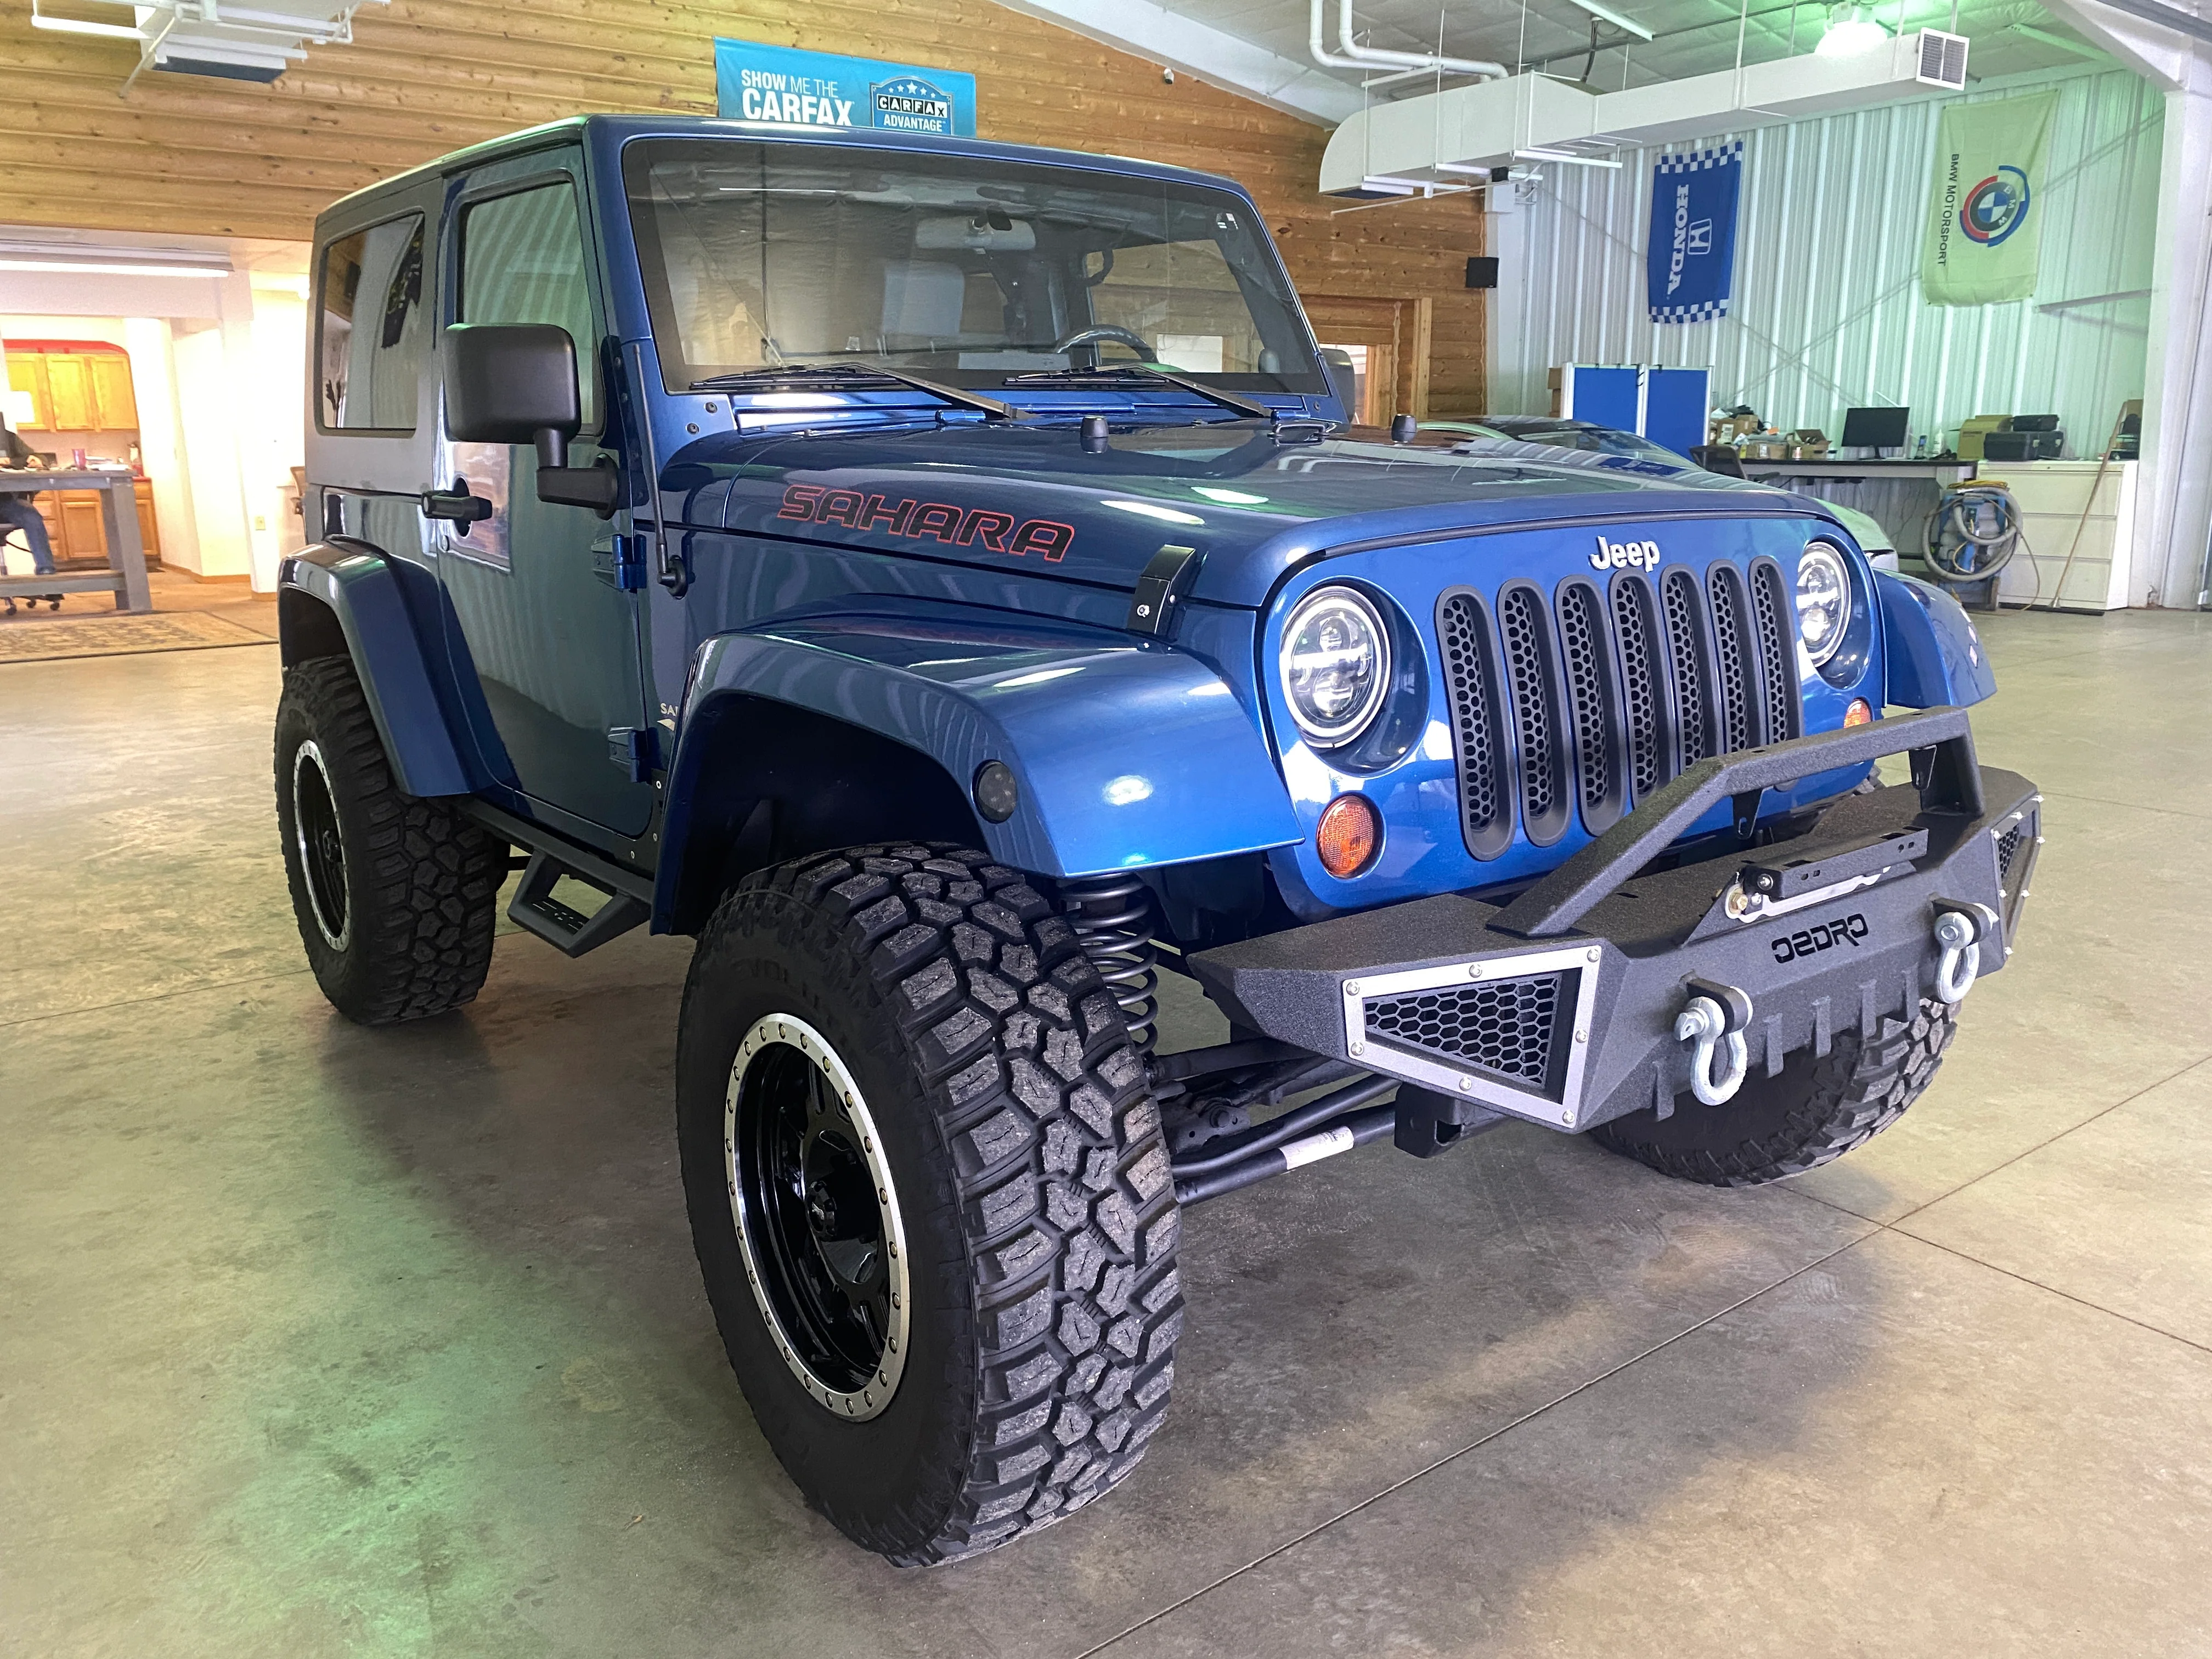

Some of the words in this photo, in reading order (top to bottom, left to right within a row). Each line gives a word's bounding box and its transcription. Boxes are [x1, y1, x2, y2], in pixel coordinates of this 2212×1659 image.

[741, 69, 786, 91] SHOW
[790, 75, 811, 95] ME
[813, 78, 839, 98] THE
[742, 87, 853, 126] CARFAX
[878, 95, 945, 118] CARFAX
[883, 114, 943, 132] ADVANTAGE
[1949, 154, 1960, 182] BMW
[1999, 185, 2016, 226] BMW
[1667, 184, 1689, 295] HONDA
[1938, 185, 1957, 267] MOTORSPORT
[777, 484, 1075, 562] SAHARA
[1589, 535, 1660, 573] Jeep
